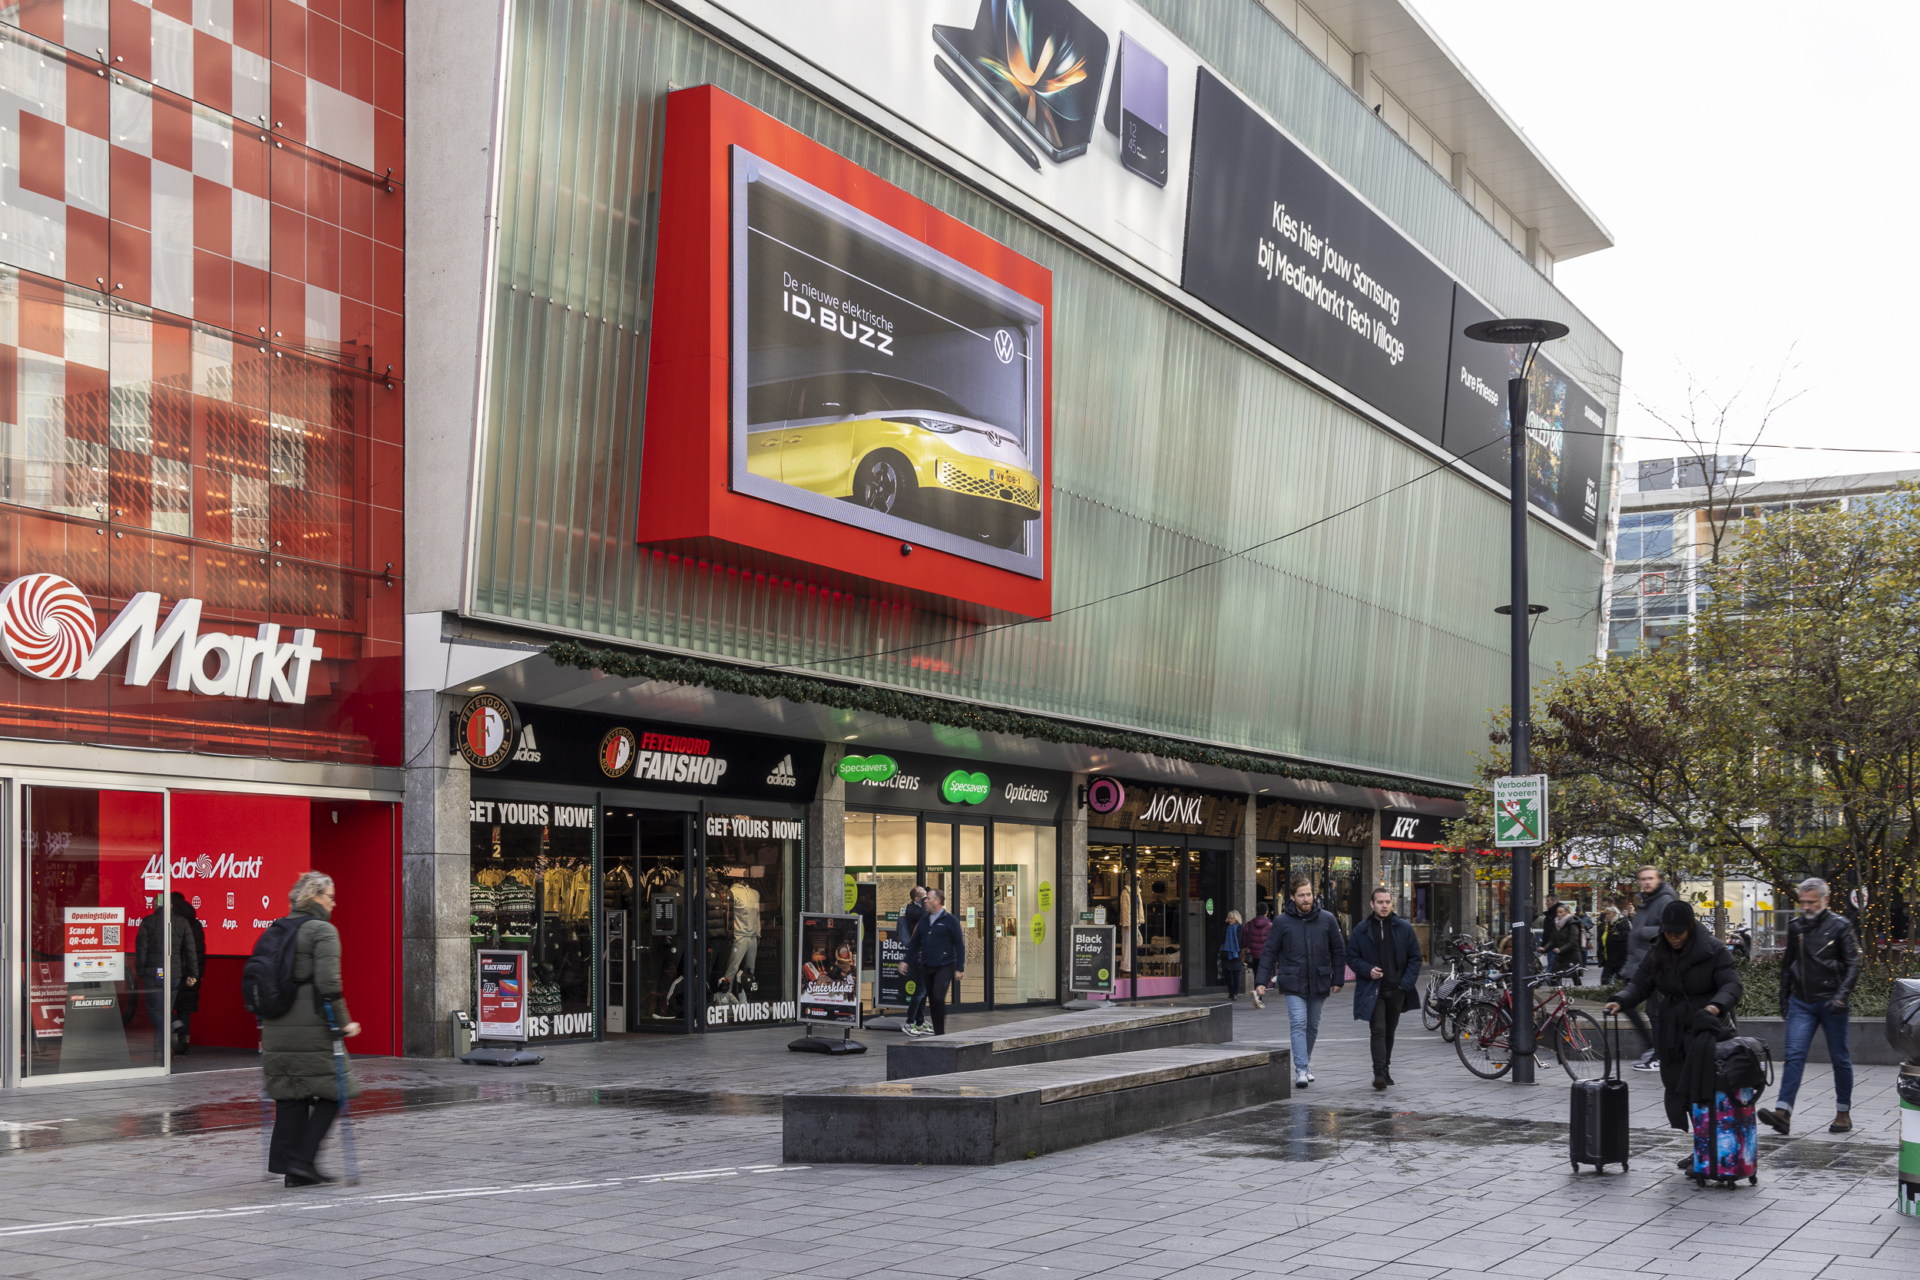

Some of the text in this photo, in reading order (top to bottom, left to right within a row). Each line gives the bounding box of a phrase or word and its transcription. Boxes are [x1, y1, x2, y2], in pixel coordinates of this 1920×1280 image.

[1272, 200, 1400, 326] Kies hier jouw Samsung
[783, 271, 894, 333] De nieuwe elektrische
[1258, 237, 1405, 366] bij MediaMarkt Tech Village
[1460, 366, 1499, 407] Pure Finesse
[76, 591, 323, 705] Markt
[462, 697, 509, 723] FEYENOORD
[462, 740, 510, 766] ROTTERDAM
[641, 732, 711, 756] FEYENOORD
[633, 749, 728, 785] FANSHOP
[839, 763, 888, 774] Specsavers
[766, 773, 797, 787] adidas
[949, 780, 988, 794] Specsavers
[1496, 780, 1538, 789] Verboden
[1004, 782, 1050, 804] Opticiens
[1497, 789, 1538, 798] te voeren
[498, 803, 549, 826] YOURS
[554, 806, 594, 828] NOW!
[706, 817, 802, 840] GET YOURS NOW!
[1390, 816, 1420, 839] KFC
[140, 853, 263, 878] Mdia Markt
[71, 912, 119, 920] Openingstijden
[128, 917, 136, 926] In
[222, 918, 238, 929] App.
[69, 927, 85, 935] Scan
[69, 937, 98, 946] QR-code
[1076, 934, 1103, 943] Black
[1075, 944, 1102, 954] Friday
[806, 981, 854, 993] Sinterklaas
[553, 1012, 592, 1034] NOW!
[707, 1005, 730, 1024] GET
[732, 1002, 770, 1022] YOURS
